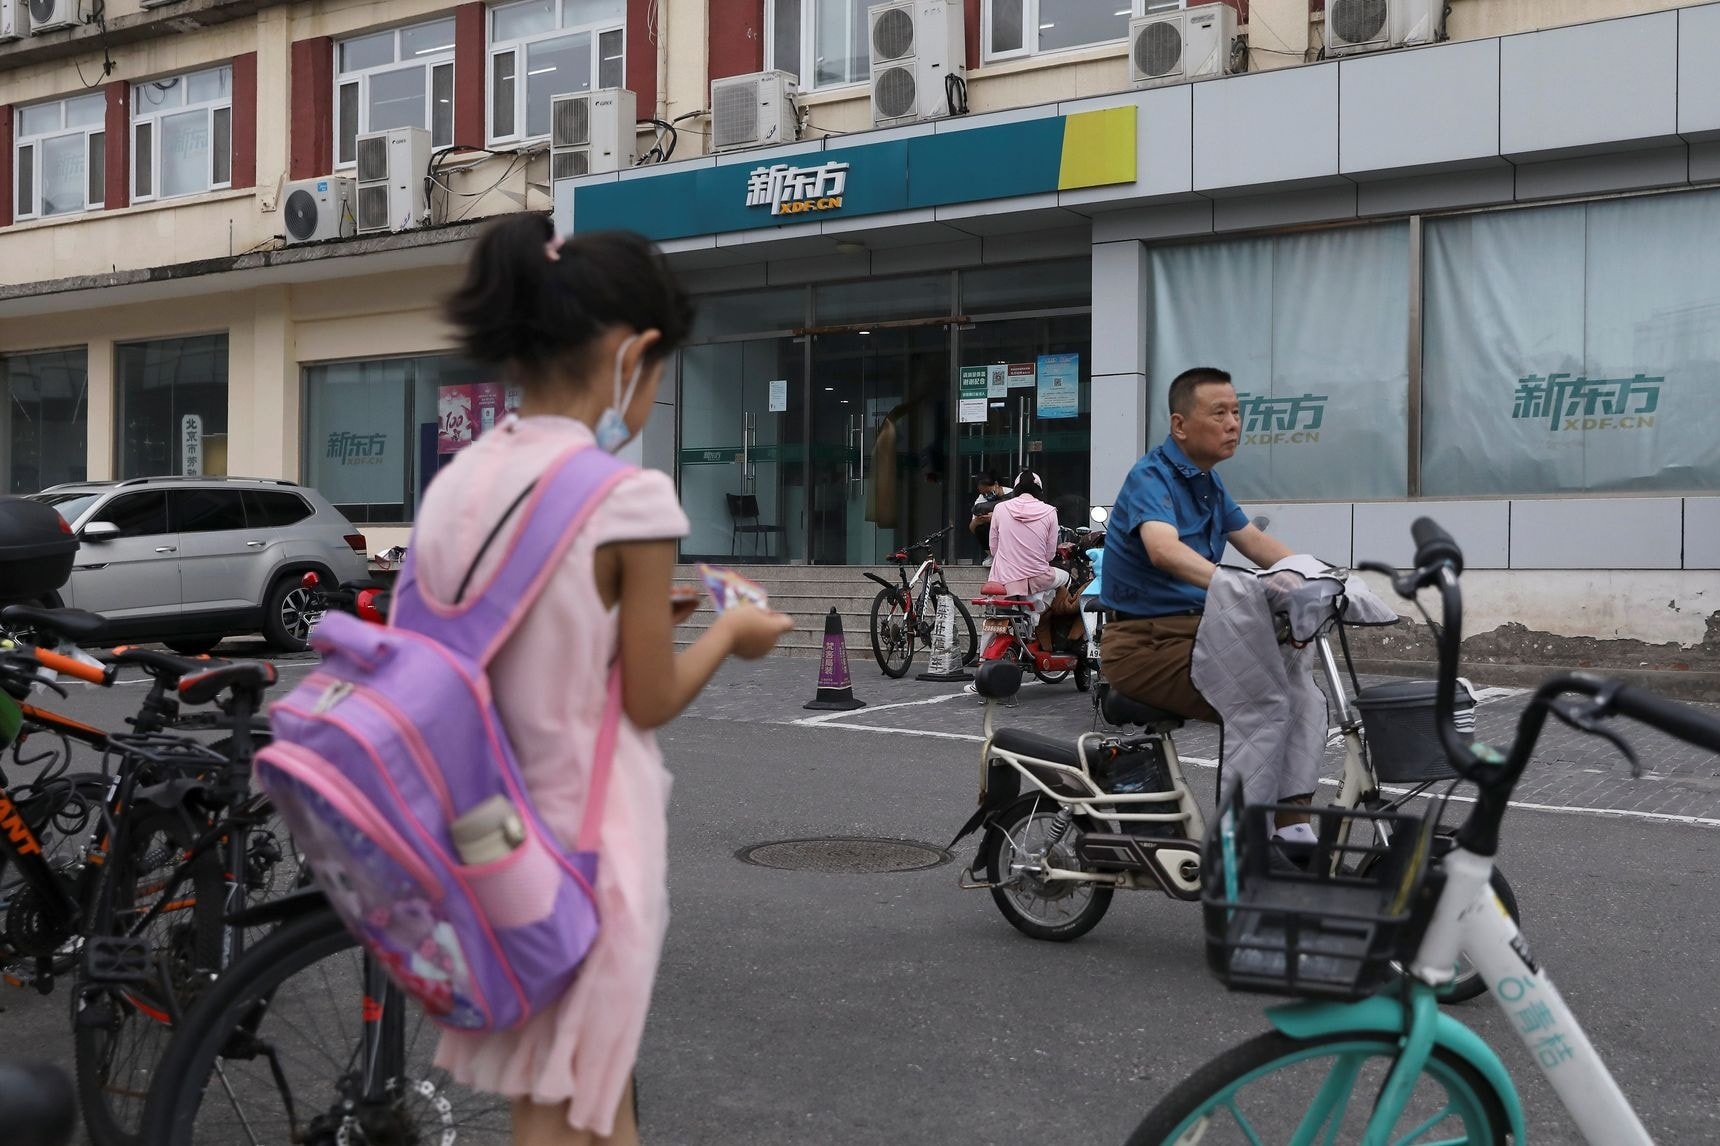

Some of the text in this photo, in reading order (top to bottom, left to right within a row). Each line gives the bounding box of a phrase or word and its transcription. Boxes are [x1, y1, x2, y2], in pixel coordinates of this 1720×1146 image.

[746, 161, 850, 215] 新东方
[780, 197, 843, 215] XDF.CN
[1512, 373, 1665, 431] 新东方
[1244, 431, 1319, 445] XDF.CN
[1563, 415, 1655, 431] XDF.CN
[326, 431, 387, 465] 新东方
[1514, 1000, 1575, 1070] 青桔
